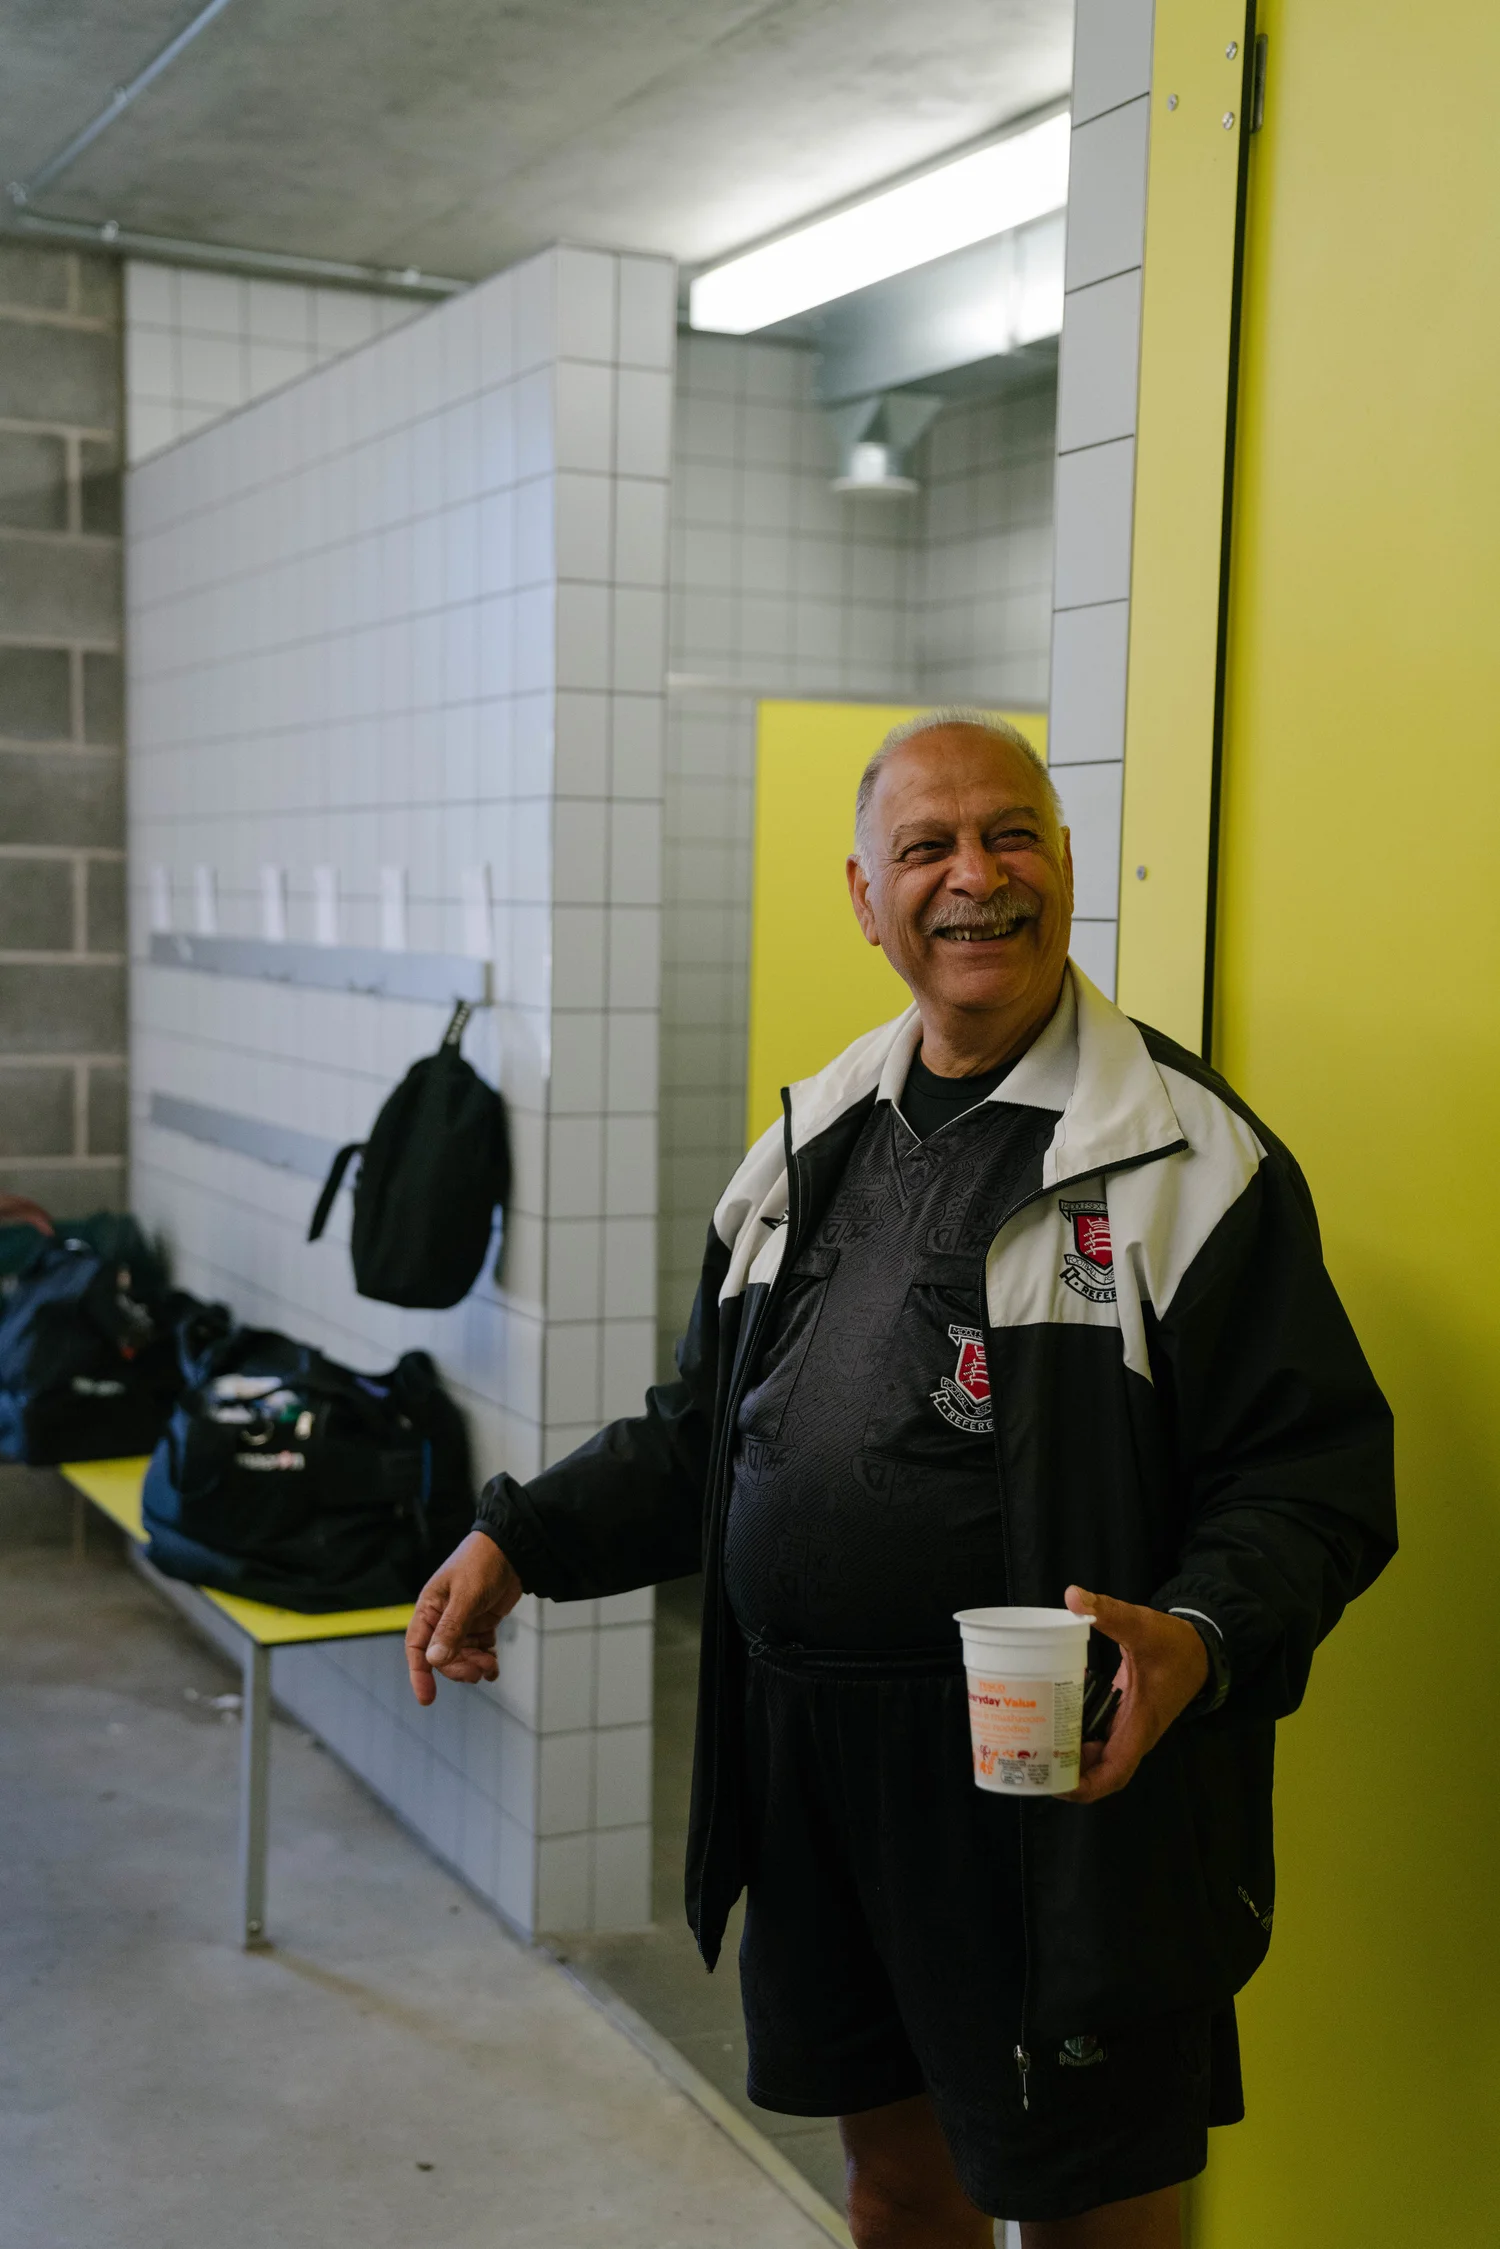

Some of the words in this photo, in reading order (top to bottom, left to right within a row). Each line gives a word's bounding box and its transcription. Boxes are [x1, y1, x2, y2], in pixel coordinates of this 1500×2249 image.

[1067, 1255, 1098, 1279] FOOTBALL
[943, 1380, 969, 1409] FOOTBALL
[946, 1410, 994, 1431] REFERE
[1003, 1696, 1037, 1709] Value
